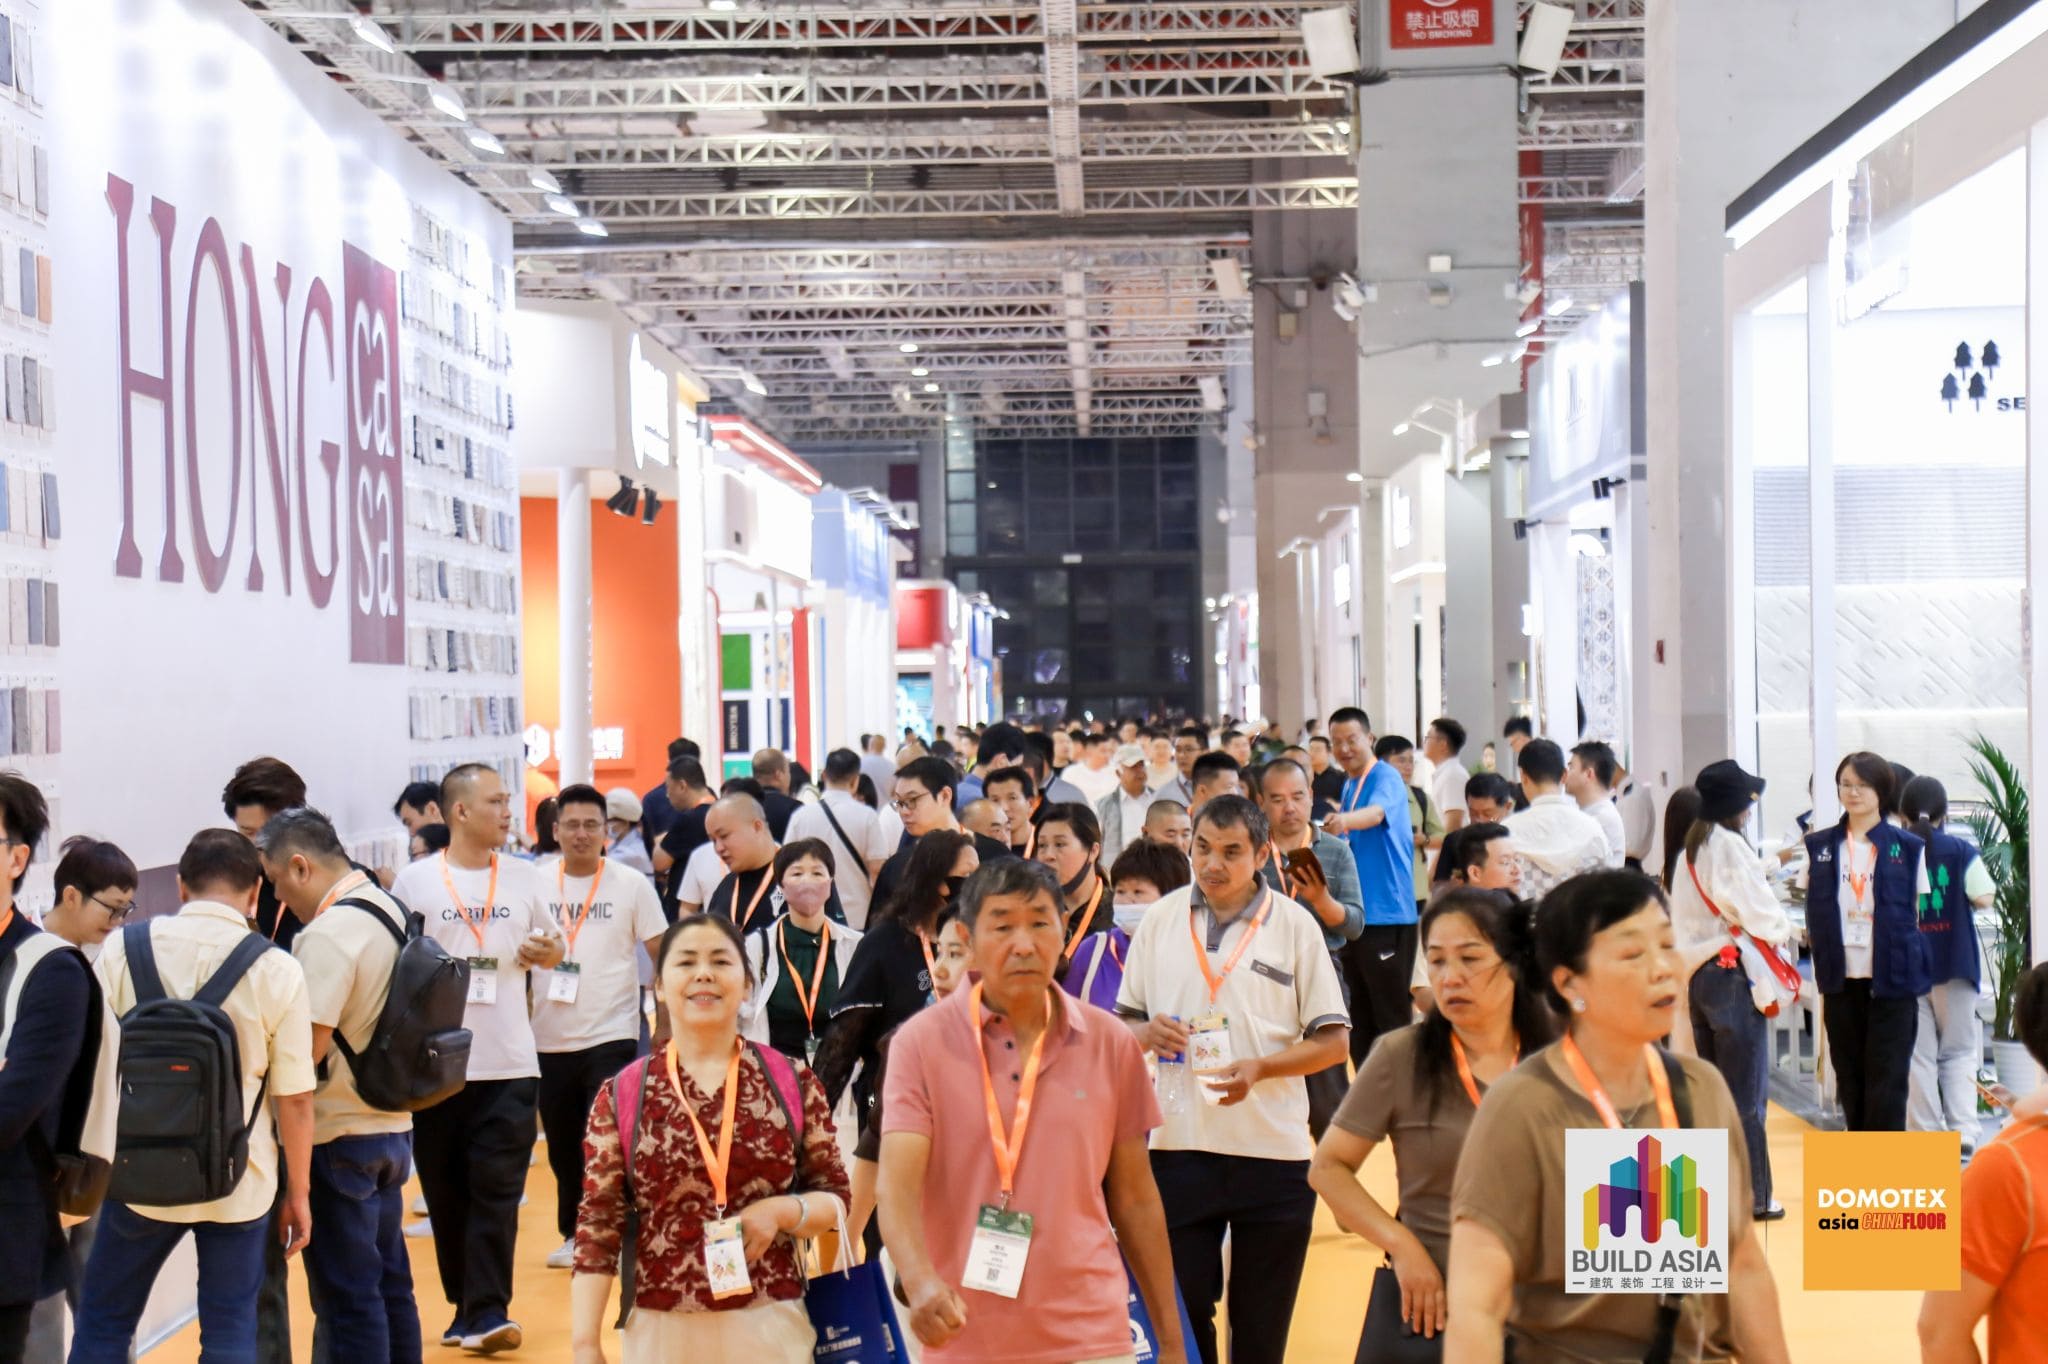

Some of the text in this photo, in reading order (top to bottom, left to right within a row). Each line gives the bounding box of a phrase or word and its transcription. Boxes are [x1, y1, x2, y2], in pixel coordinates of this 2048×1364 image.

[1406, 9, 1479, 30] 禁止吸烟
[1412, 29, 1473, 40] NO SMOKING
[105, 172, 341, 609] HONG
[353, 299, 395, 458] ca
[356, 468, 398, 618] sa
